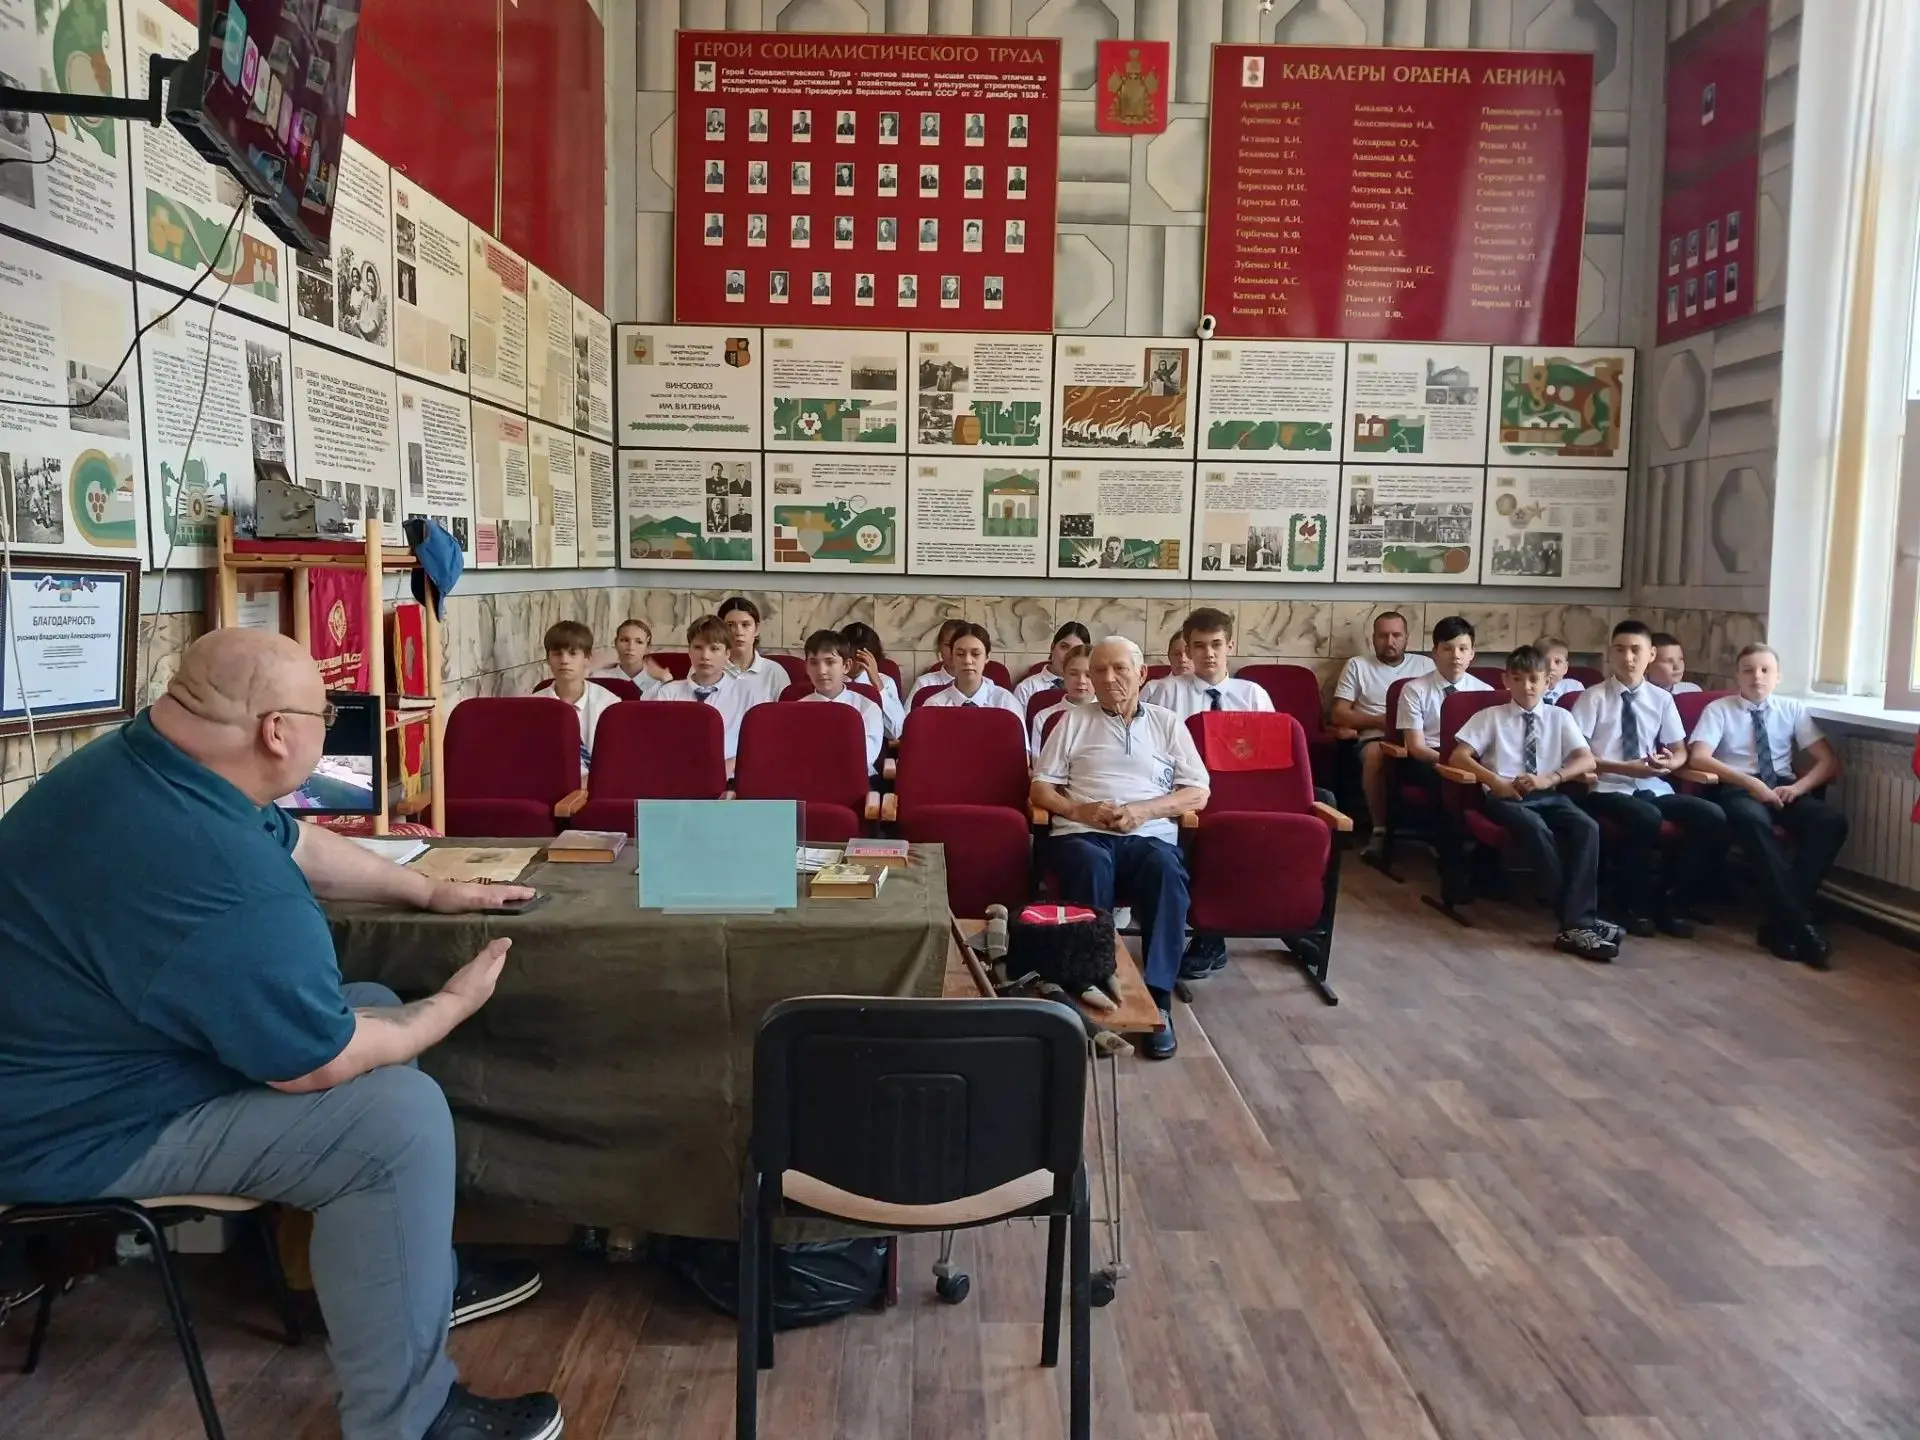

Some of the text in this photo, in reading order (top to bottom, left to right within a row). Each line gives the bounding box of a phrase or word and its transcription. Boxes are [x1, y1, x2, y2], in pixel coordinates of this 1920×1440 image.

[694, 42, 1044, 64] ГЕРОИ СОЦИАЛИСТИЧЕСКОГО ТРУДА
[722, 67, 745, 76] Герой
[748, 68, 825, 77] Социалистического
[828, 69, 851, 78] Труда
[861, 70, 897, 78] почетное
[1002, 74, 1034, 82] отличия
[1037, 74, 1047, 82] за
[1283, 63, 1566, 86] КАВАЛЕРЫ ОРДЕНА ЛЕНИНА
[857, 80, 917, 88] хозяйственном
[934, 82, 980, 90] культурном
[722, 86, 769, 94] Утверждено
[772, 86, 802, 94] Указом
[805, 87, 853, 96] Президиума
[856, 88, 901, 96] Верховного
[905, 88, 932, 97] Совета
[973, 90, 983, 98] 27
[1236, 214, 1280, 224] Гончарова
[665, 382, 713, 390] ВИНСОВХОЗ
[32, 616, 96, 626] БЛАГОДАРНОСТЬ
[39, 632, 70, 640] Владиславу
[70, 632, 111, 640] Александровичу
